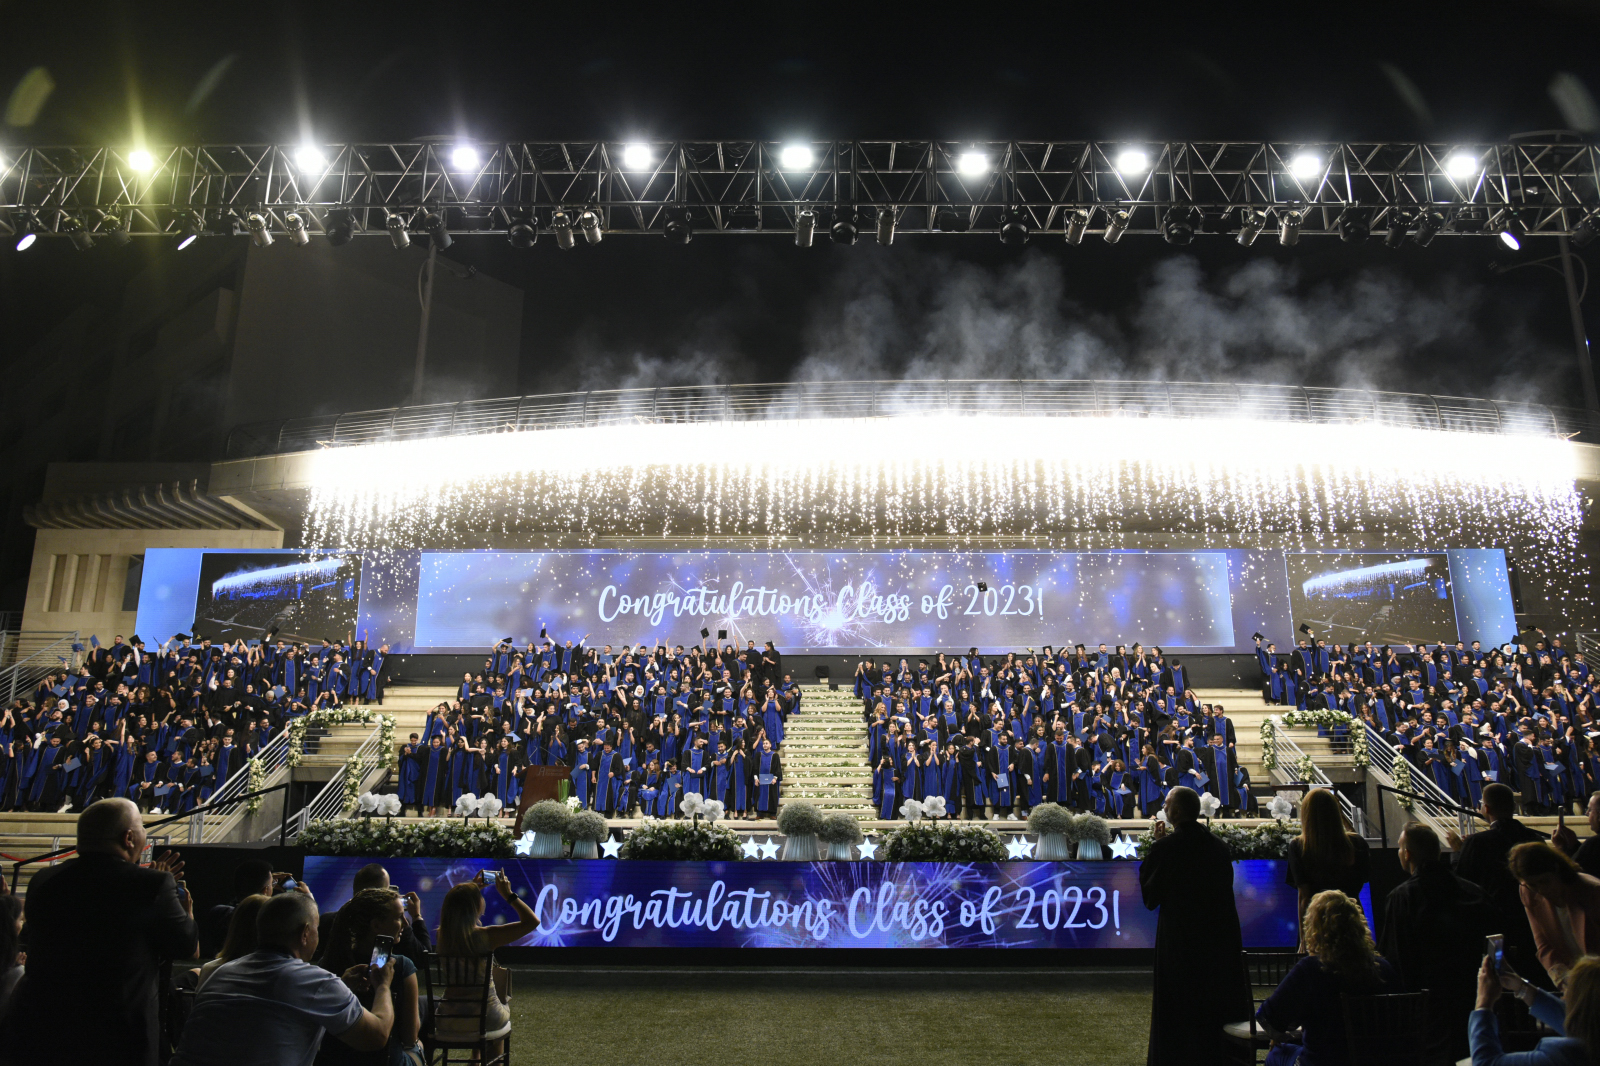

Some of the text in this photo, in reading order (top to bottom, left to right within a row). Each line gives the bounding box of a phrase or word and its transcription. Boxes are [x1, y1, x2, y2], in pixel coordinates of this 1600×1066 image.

[598, 581, 1044, 627] Congratulations Class of 2023!
[534, 880, 1120, 942] Congratulations Class of 2023!
